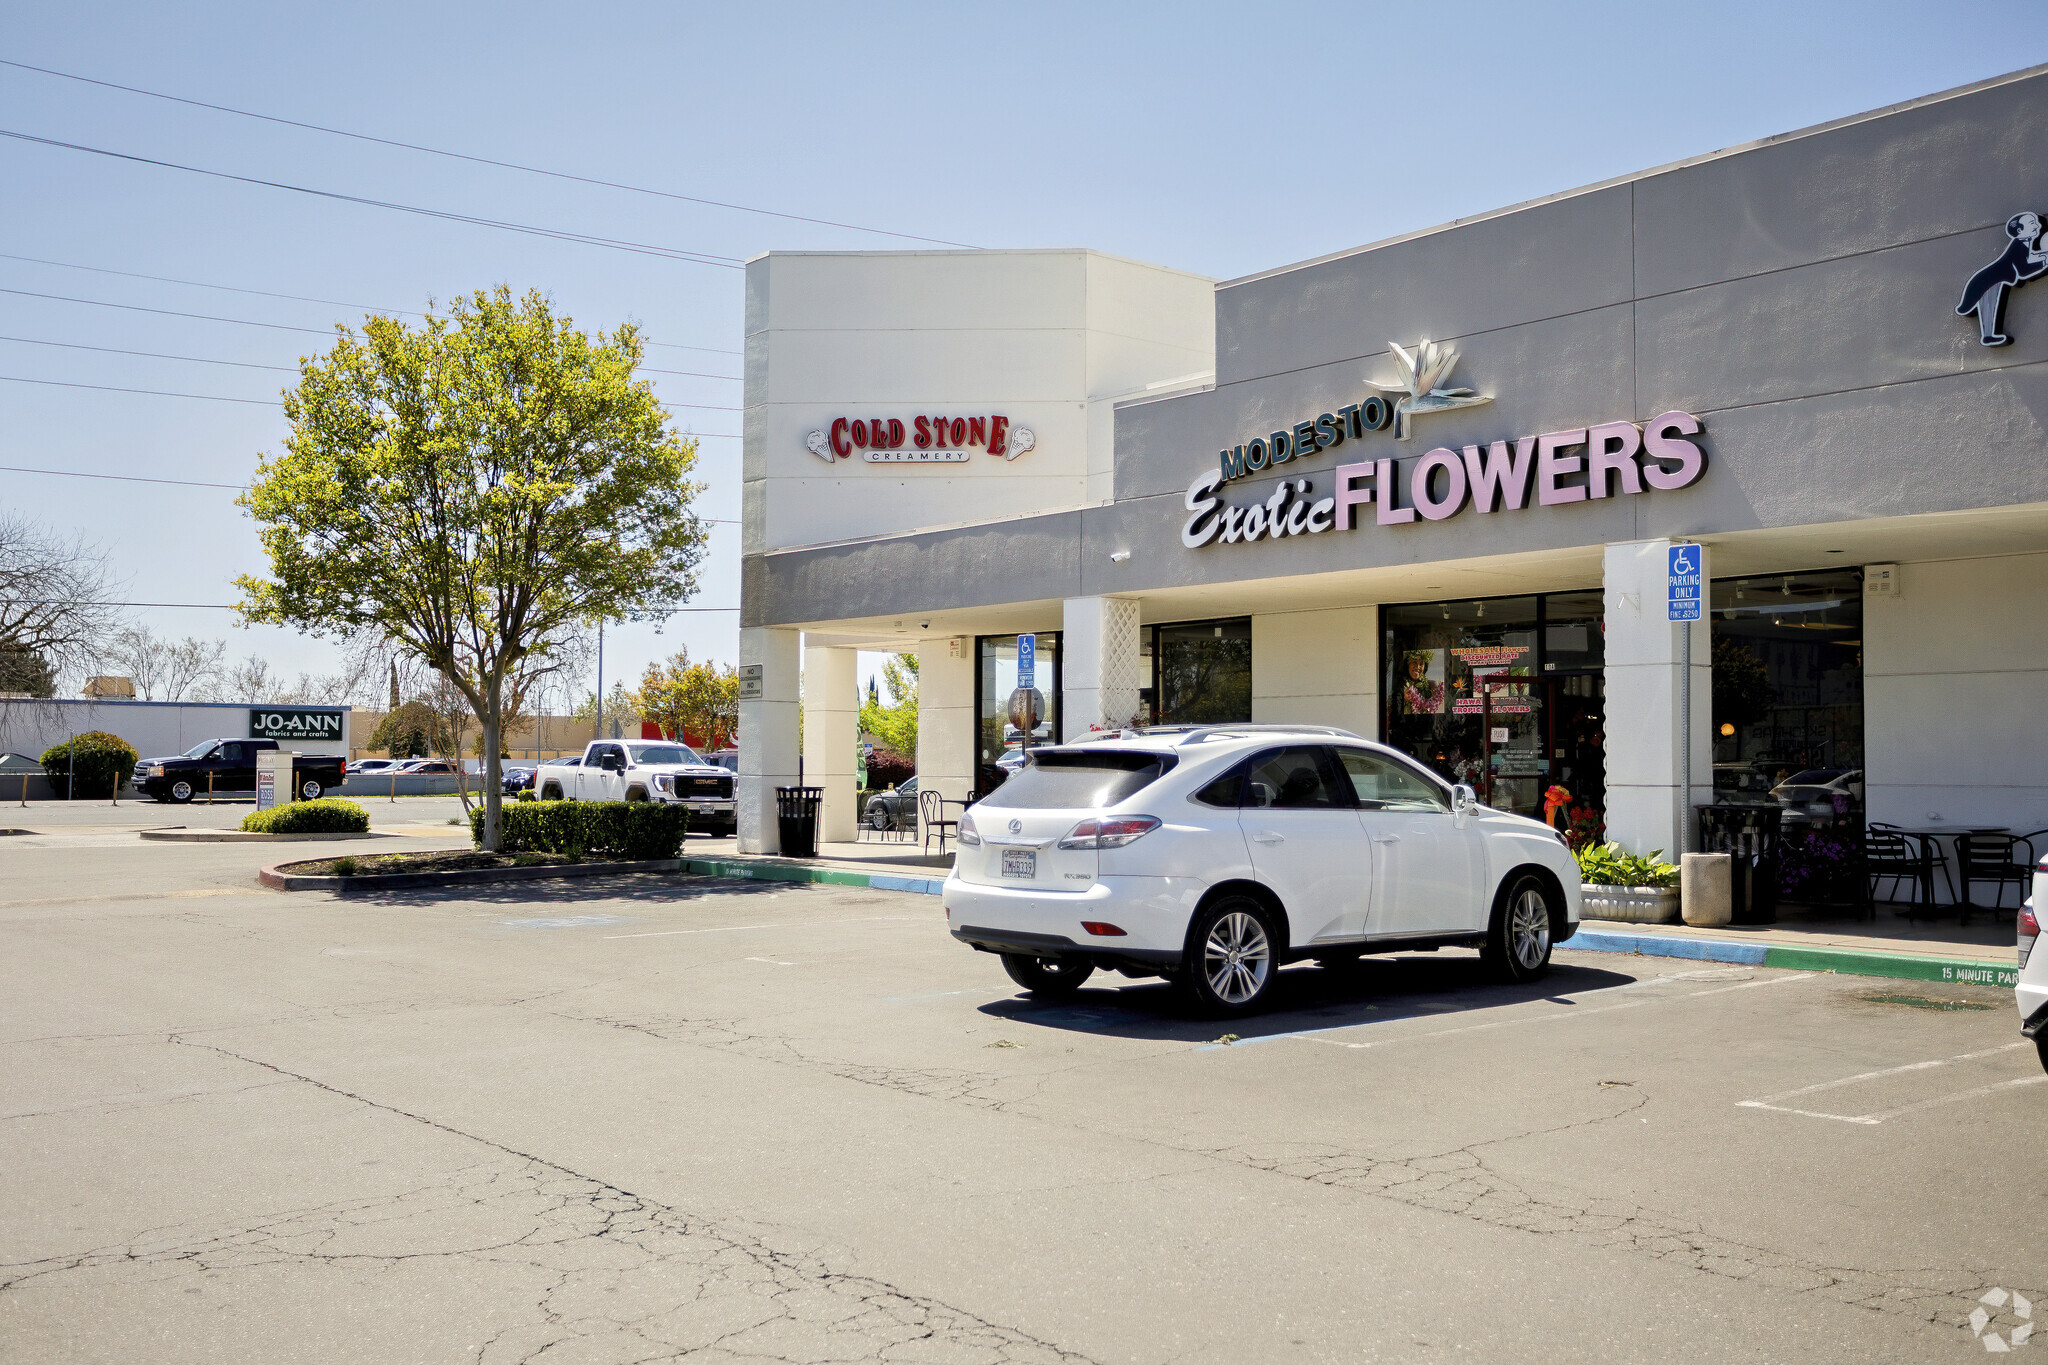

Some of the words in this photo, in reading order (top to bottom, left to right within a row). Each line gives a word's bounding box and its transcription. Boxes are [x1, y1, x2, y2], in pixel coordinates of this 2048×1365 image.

[831, 416, 905, 459] COLD
[913, 415, 1010, 457] STONE
[1219, 395, 1391, 482] MODESTO
[872, 452, 963, 461] CREAMERY
[1181, 468, 1335, 549] Exotic
[1335, 410, 1705, 532] FLOWERS
[1669, 574, 1700, 587] PARKING
[1675, 587, 1694, 599] ONLY
[1673, 601, 1696, 610] MINIMUM
[1670, 610, 1681, 619] FINE
[1450, 646, 1500, 656] WHOLESALE
[746, 681, 755, 689] NO
[1493, 704, 1531, 714] FLOWERS
[1942, 967, 1952, 979] 15
[1956, 968, 1993, 983] MINUTE
